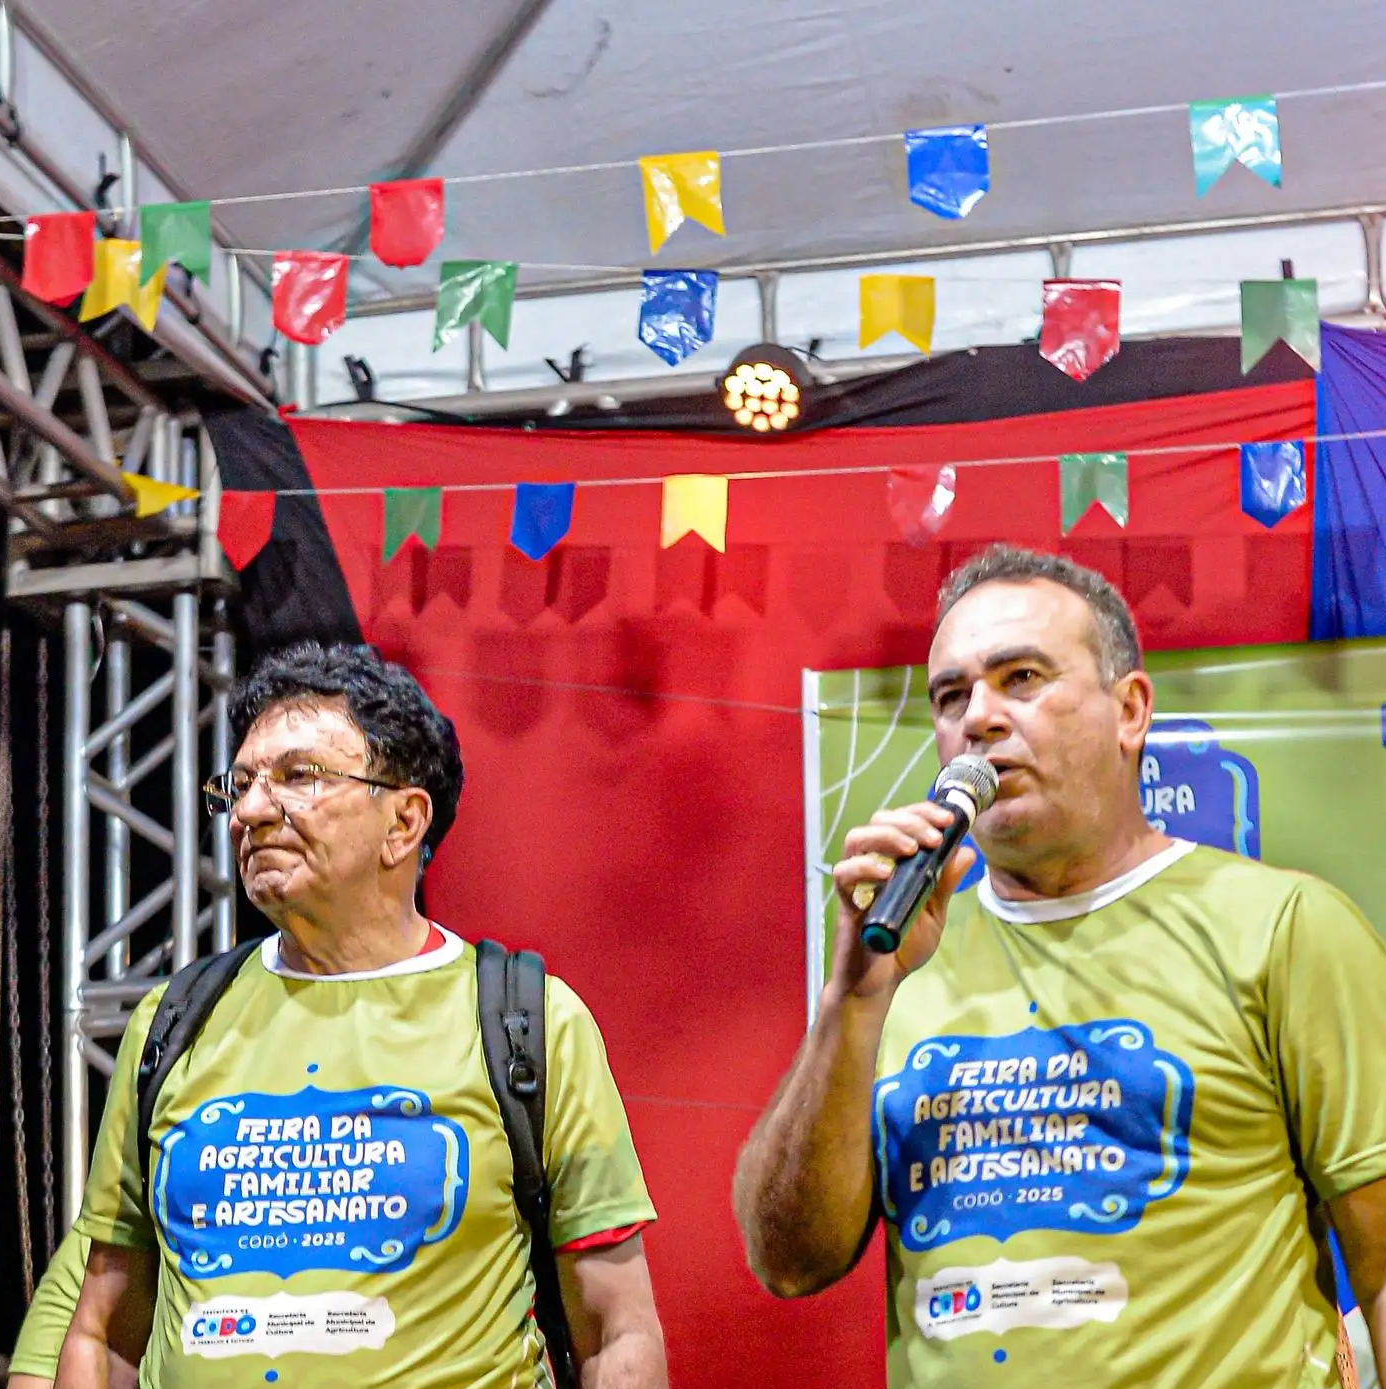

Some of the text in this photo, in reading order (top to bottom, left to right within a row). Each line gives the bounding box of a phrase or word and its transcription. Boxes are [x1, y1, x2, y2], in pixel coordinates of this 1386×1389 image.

[948, 1049, 1089, 1087] FEIRA DA
[914, 1079, 1123, 1125] AGRICULTURA
[236, 1114, 372, 1143] FEIRA DA
[938, 1113, 1091, 1153] FAMILIAR
[198, 1140, 407, 1172] AGRICULTURA
[909, 1145, 1126, 1193] E ARTESANATO
[223, 1168, 376, 1199] FAMILIAR
[952, 1186, 1064, 1210] CODÓ 2025
[191, 1195, 408, 1230] E ARTESANATO
[237, 1232, 346, 1250] CODÓ 2025
[928, 1282, 982, 1319] CODÓ
[192, 1314, 257, 1338] CODÓ
